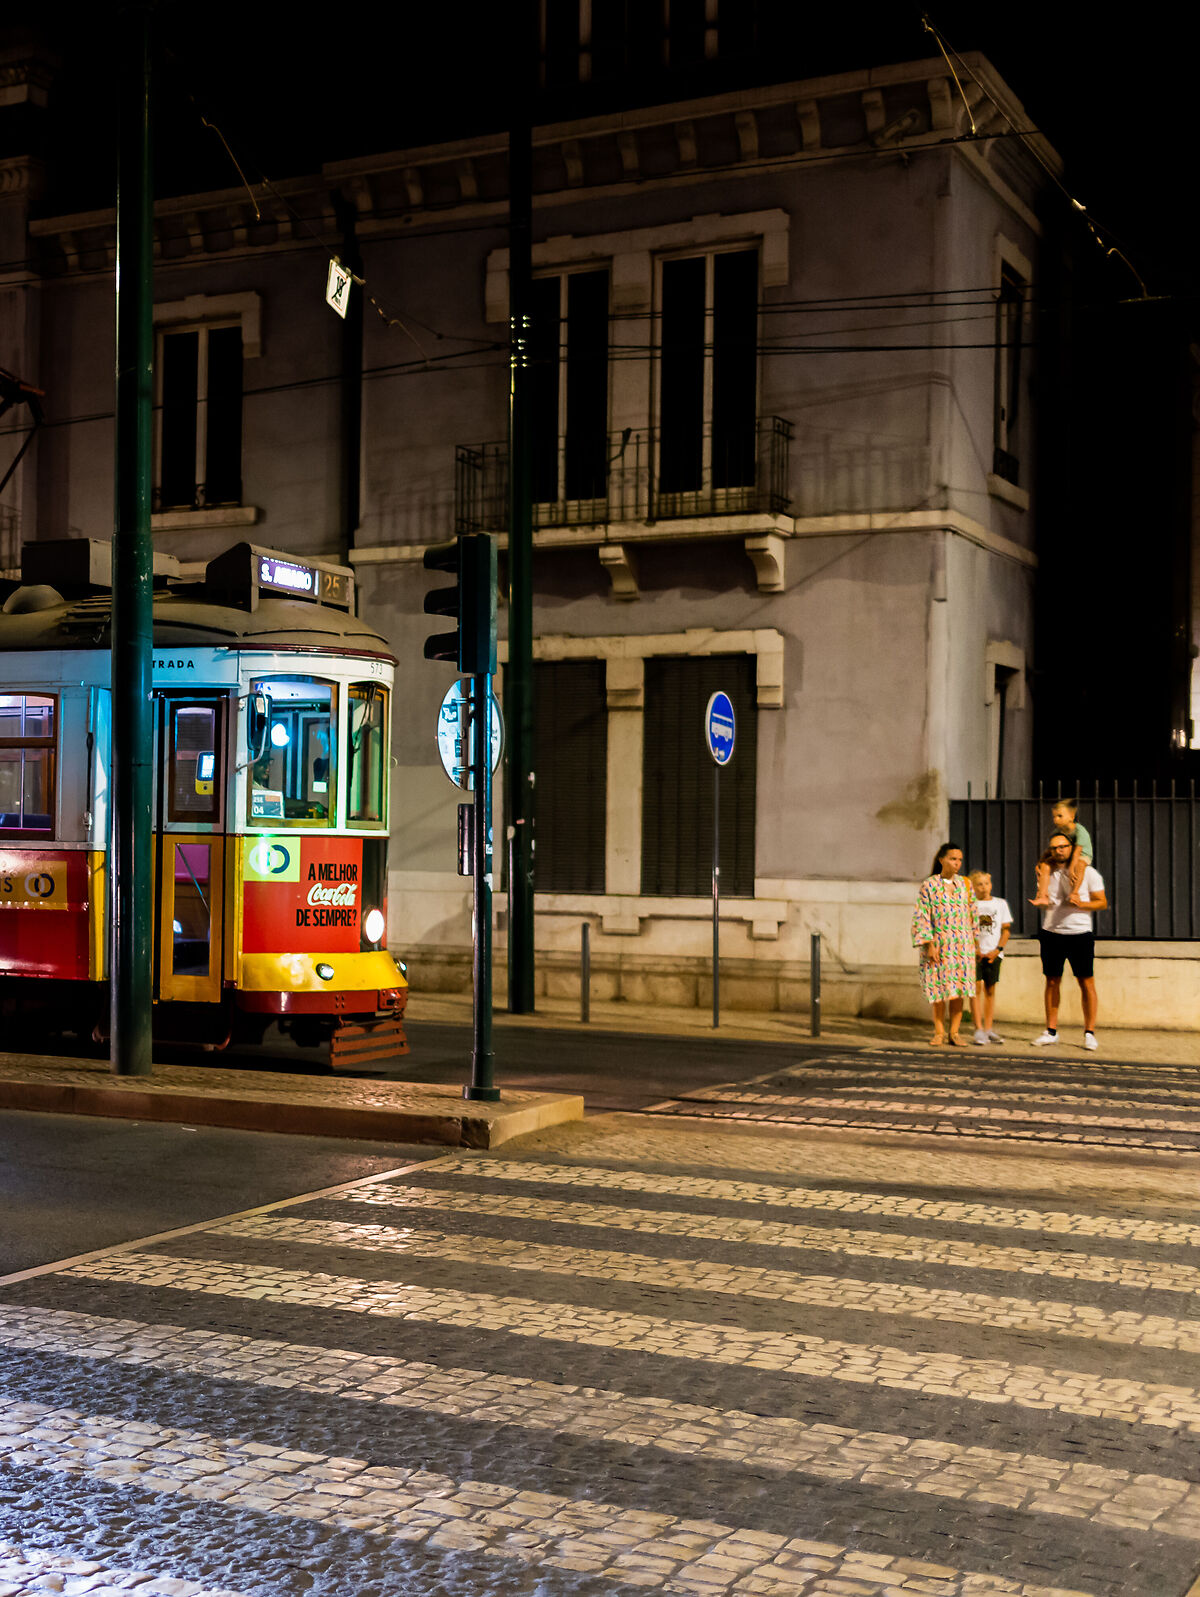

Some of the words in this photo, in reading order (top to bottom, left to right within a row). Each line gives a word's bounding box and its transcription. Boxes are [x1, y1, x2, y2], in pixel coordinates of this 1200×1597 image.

[324, 574, 340, 594] 25
[152, 660, 195, 669] TRADA
[370, 662, 383, 675] 573
[253, 806, 264, 815] 04
[308, 863, 316, 881] A
[318, 863, 358, 882] MELHOR
[296, 909, 311, 927] DE
[312, 909, 357, 927] SEMPRE?
